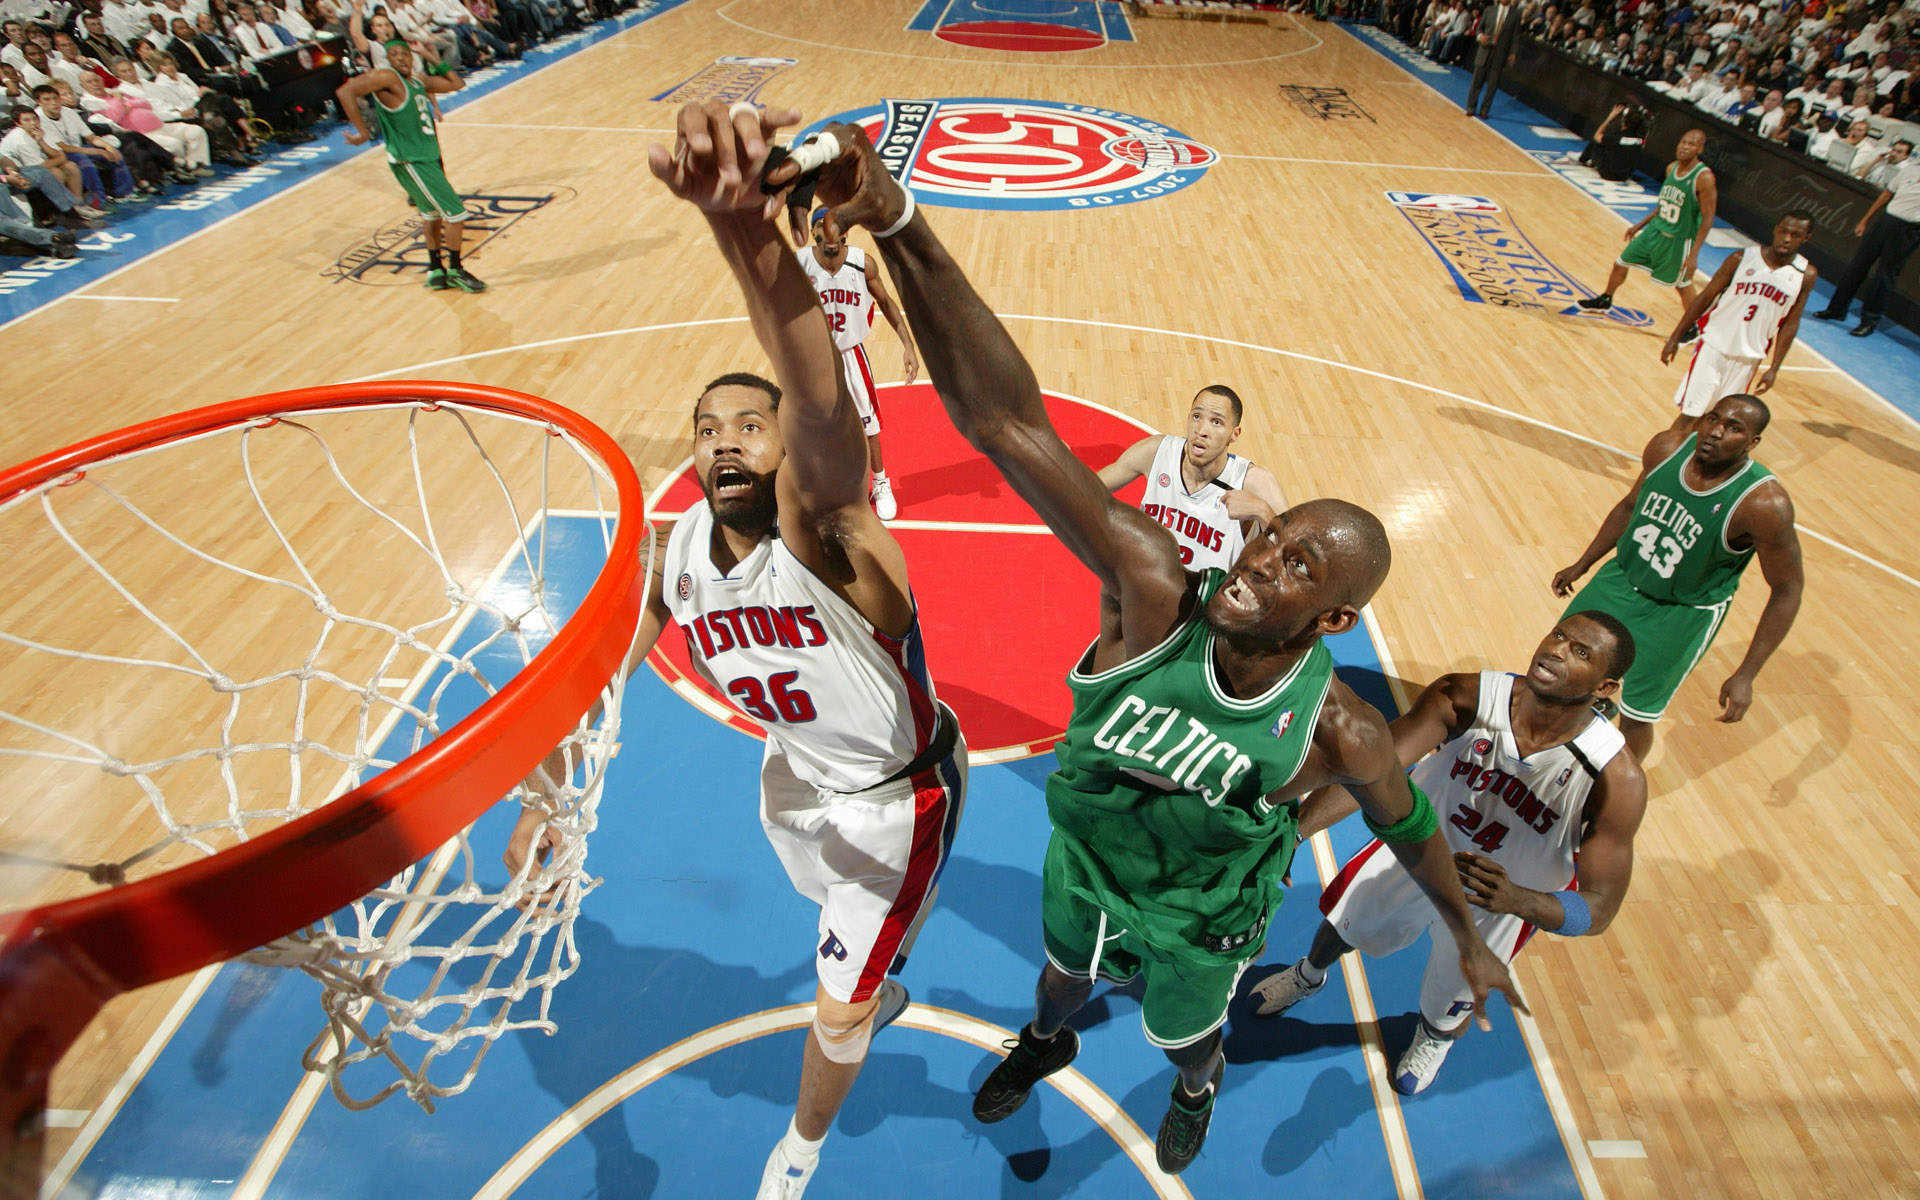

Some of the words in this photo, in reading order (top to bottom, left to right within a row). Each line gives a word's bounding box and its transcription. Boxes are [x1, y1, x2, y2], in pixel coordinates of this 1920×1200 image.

[926, 116, 1083, 177] 50
[1067, 174, 1187, 207] 2007-08
[1659, 200, 1681, 224] 20
[1406, 207, 1472, 258] FINALS
[1456, 261, 1521, 309] 2008
[819, 288, 862, 308] STONS
[1734, 281, 1790, 307] PISTONS
[1743, 305, 1759, 322] 3
[1640, 491, 1704, 551] CELTICS
[1633, 522, 1684, 579] 43
[727, 669, 818, 724] 36
[1093, 694, 1253, 808] CELTICS
[1449, 754, 1561, 836] PISTONS
[1449, 803, 1511, 854] 24
